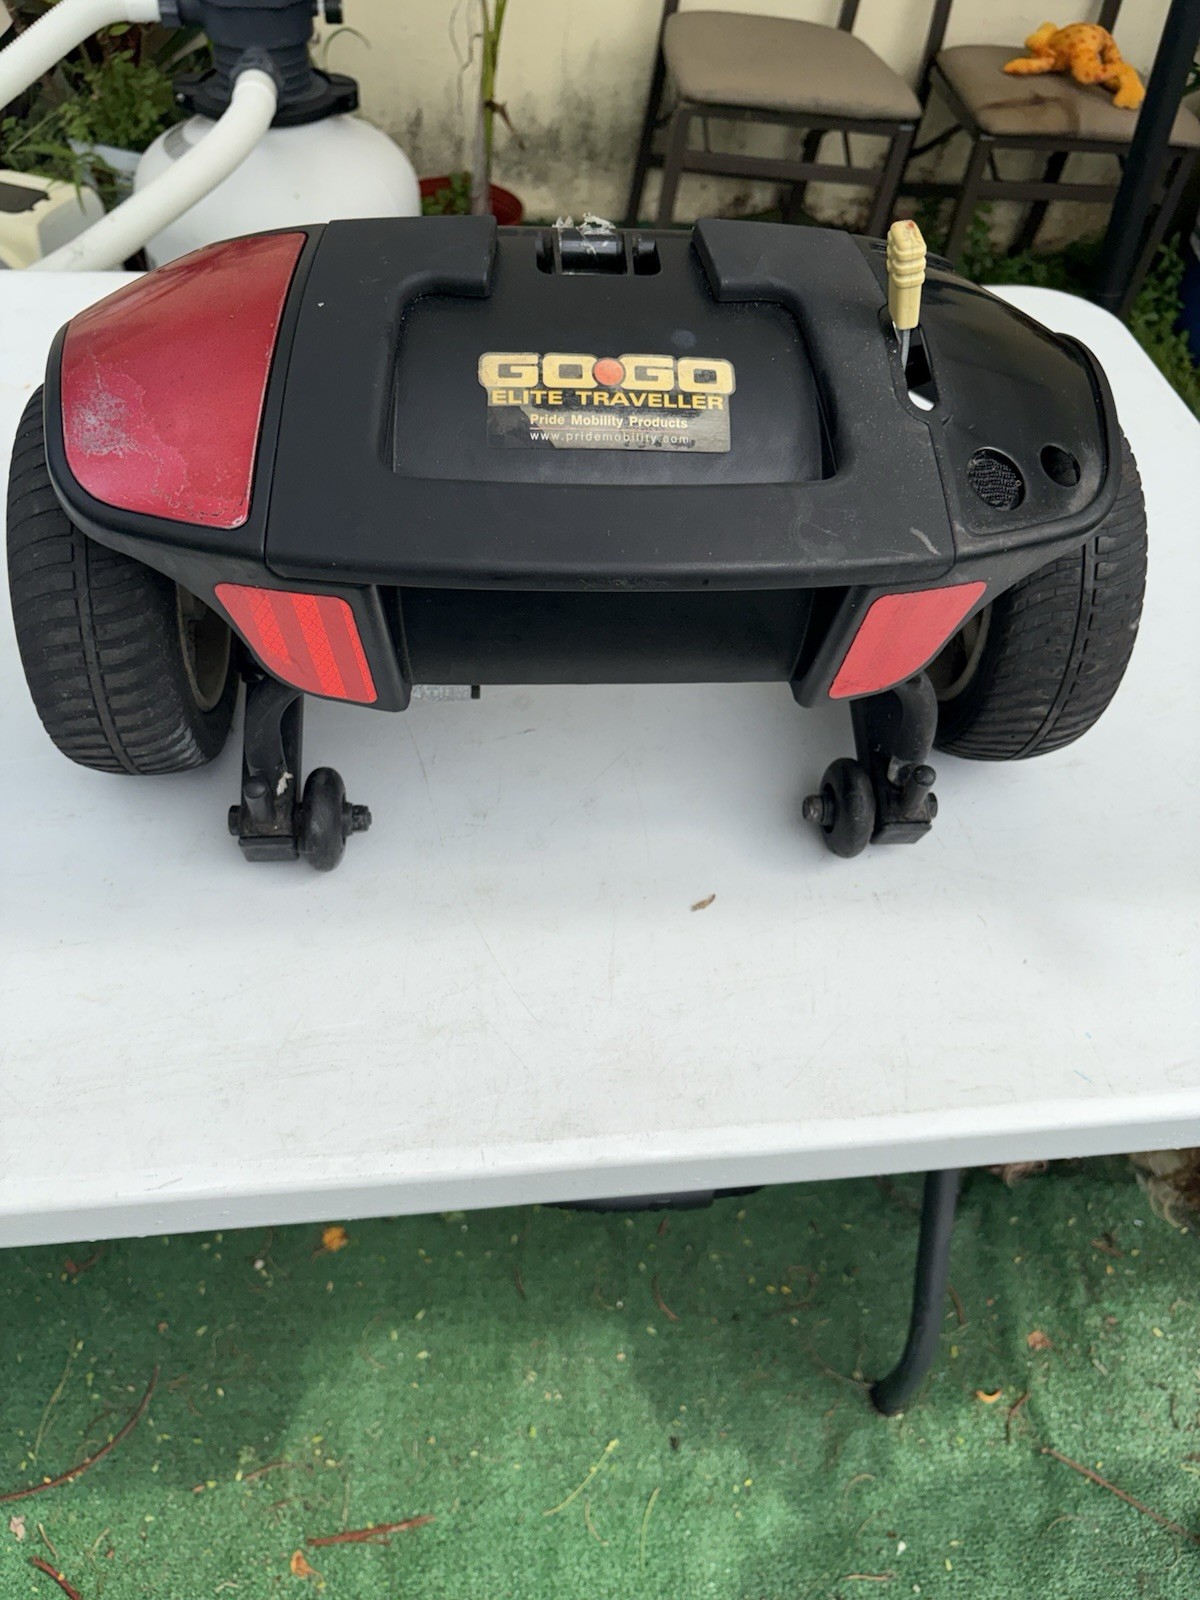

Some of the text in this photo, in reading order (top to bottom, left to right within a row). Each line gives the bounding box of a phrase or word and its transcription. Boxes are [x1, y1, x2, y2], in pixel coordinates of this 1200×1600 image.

[492, 390, 723, 410] ELITE TRAVELLER
[530, 415, 688, 429] Pride Mobility Products
[530, 432, 689, 445] www.pridemobility.com
